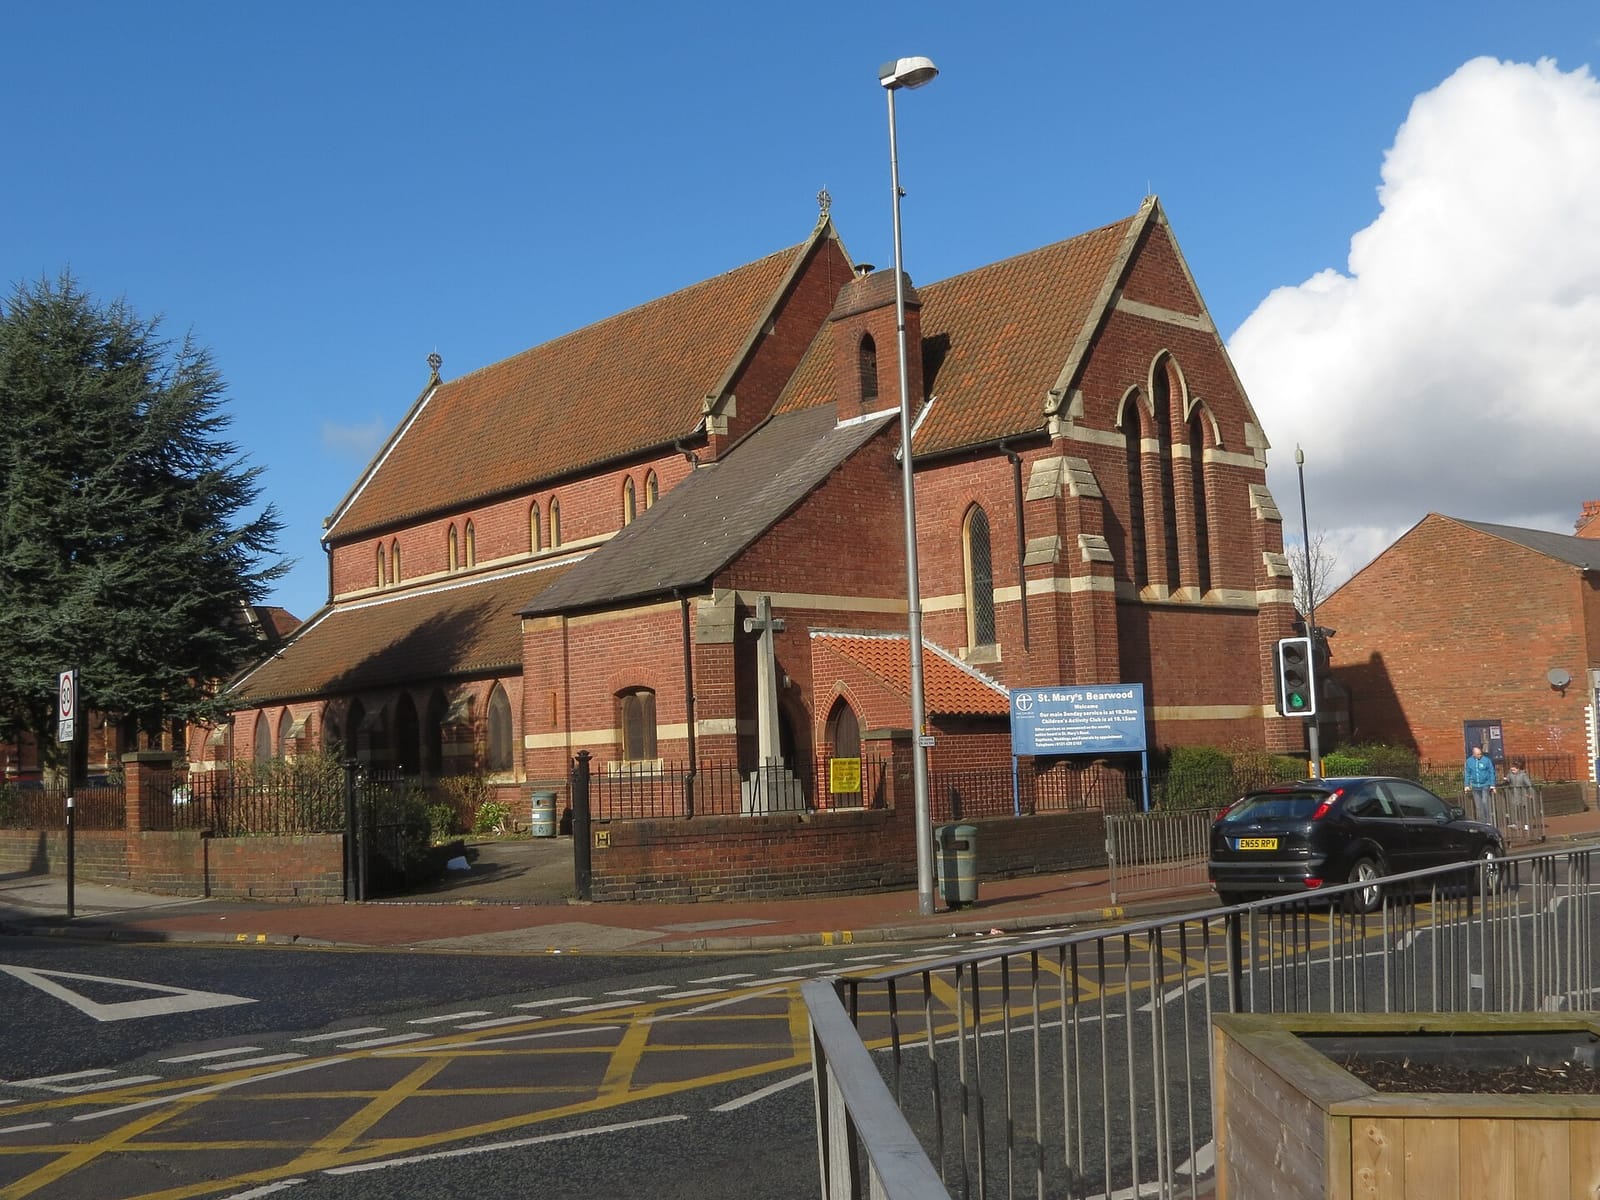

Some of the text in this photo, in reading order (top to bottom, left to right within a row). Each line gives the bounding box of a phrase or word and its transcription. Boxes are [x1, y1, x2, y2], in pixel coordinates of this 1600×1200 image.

[63, 688, 70, 704] 30
[1037, 690, 1133, 703] St. Mary's Bearwood
[1240, 839, 1276, 848] EN55 RPV
